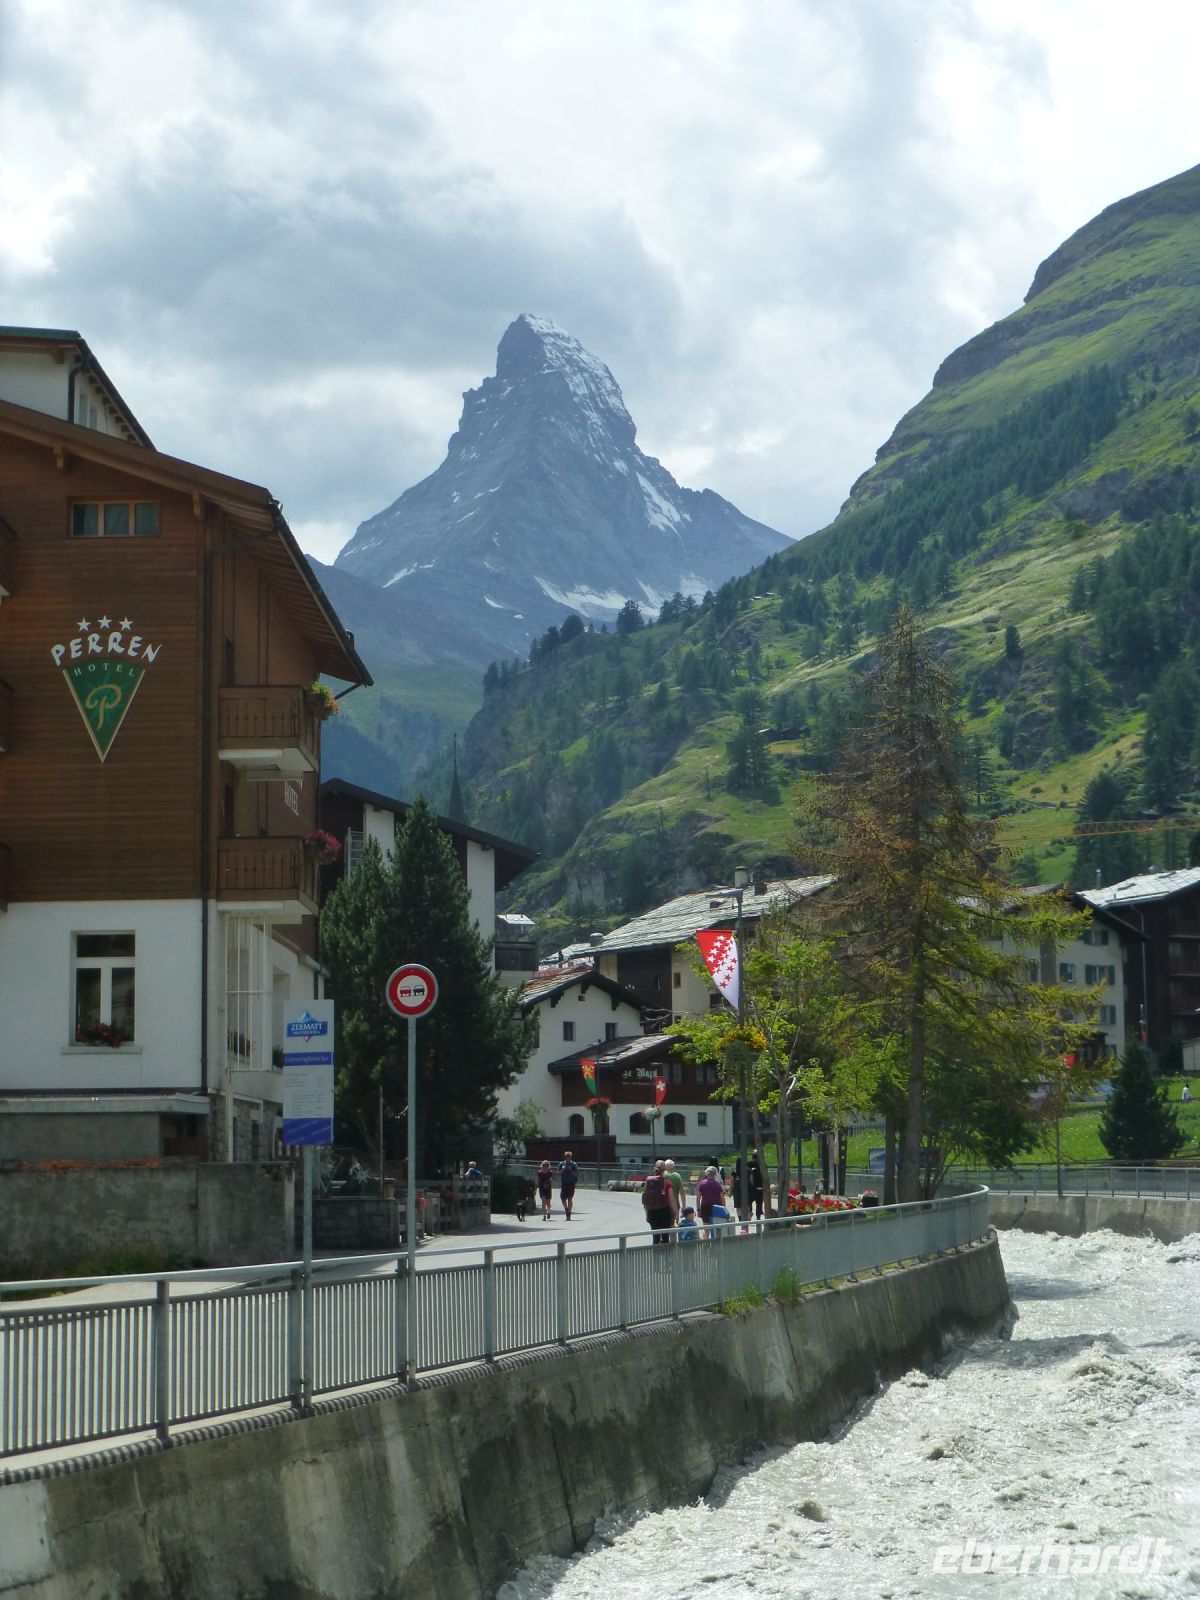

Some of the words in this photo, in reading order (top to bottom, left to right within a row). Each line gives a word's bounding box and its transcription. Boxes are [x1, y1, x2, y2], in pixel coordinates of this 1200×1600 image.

[51, 631, 162, 667] PERREN
[74, 663, 135, 677] HOTEL
[291, 1023, 323, 1031] ZERMATT
